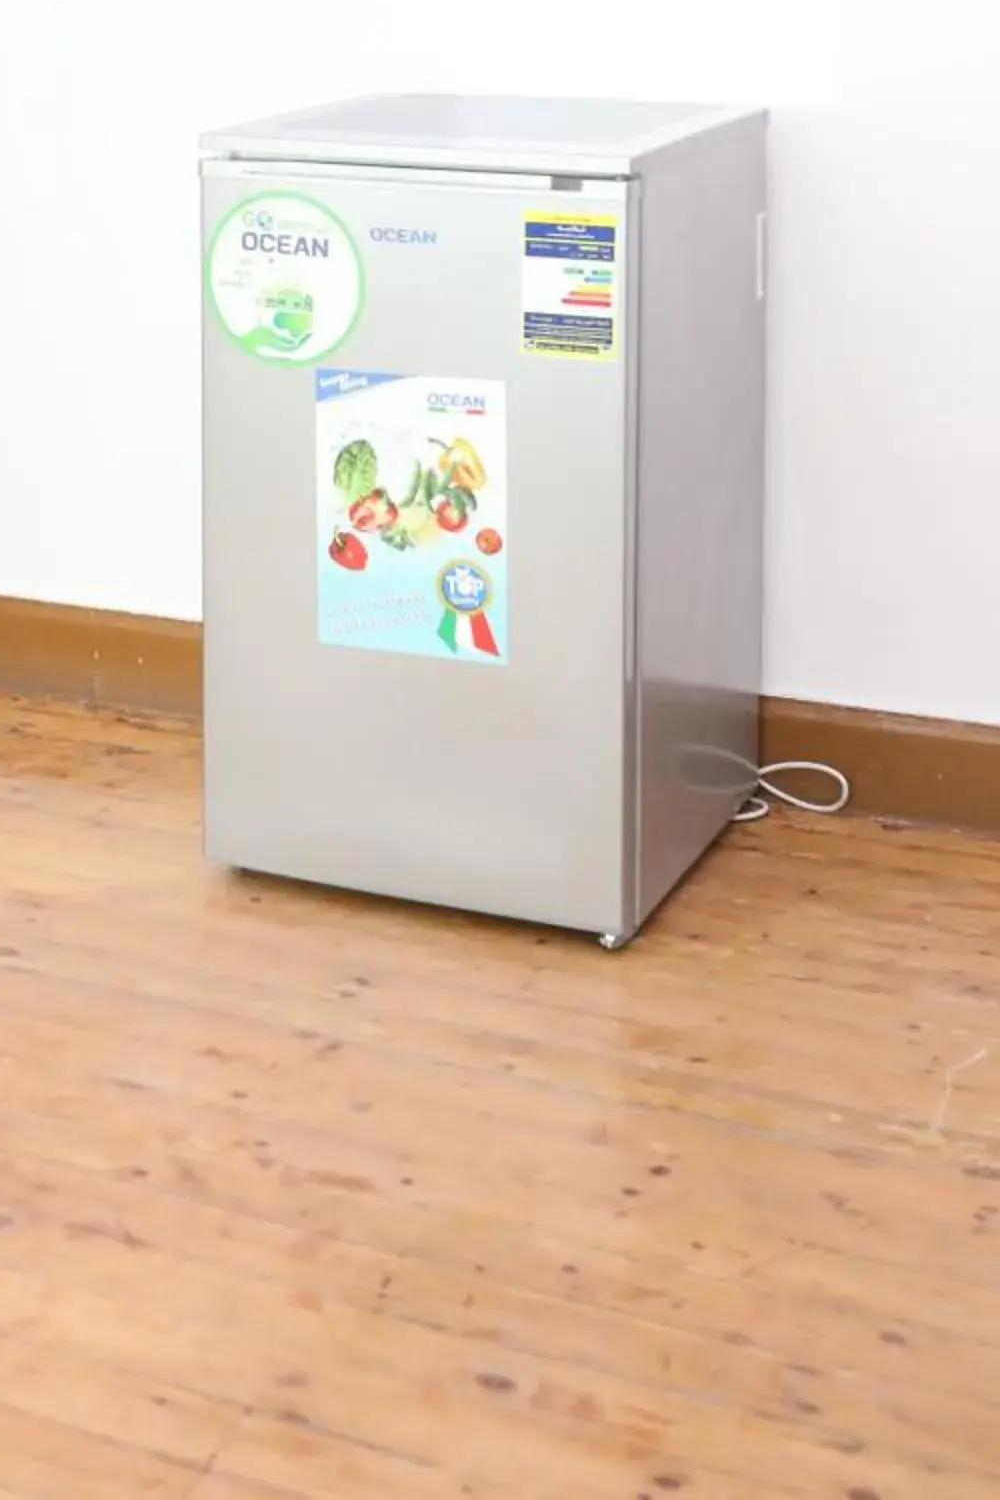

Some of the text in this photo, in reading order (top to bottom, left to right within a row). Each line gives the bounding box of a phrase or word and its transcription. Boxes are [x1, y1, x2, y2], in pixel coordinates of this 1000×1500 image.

[241, 230, 330, 259] OCEAN
[369, 227, 438, 245] OCEAN
[427, 391, 486, 409] OCEAN
